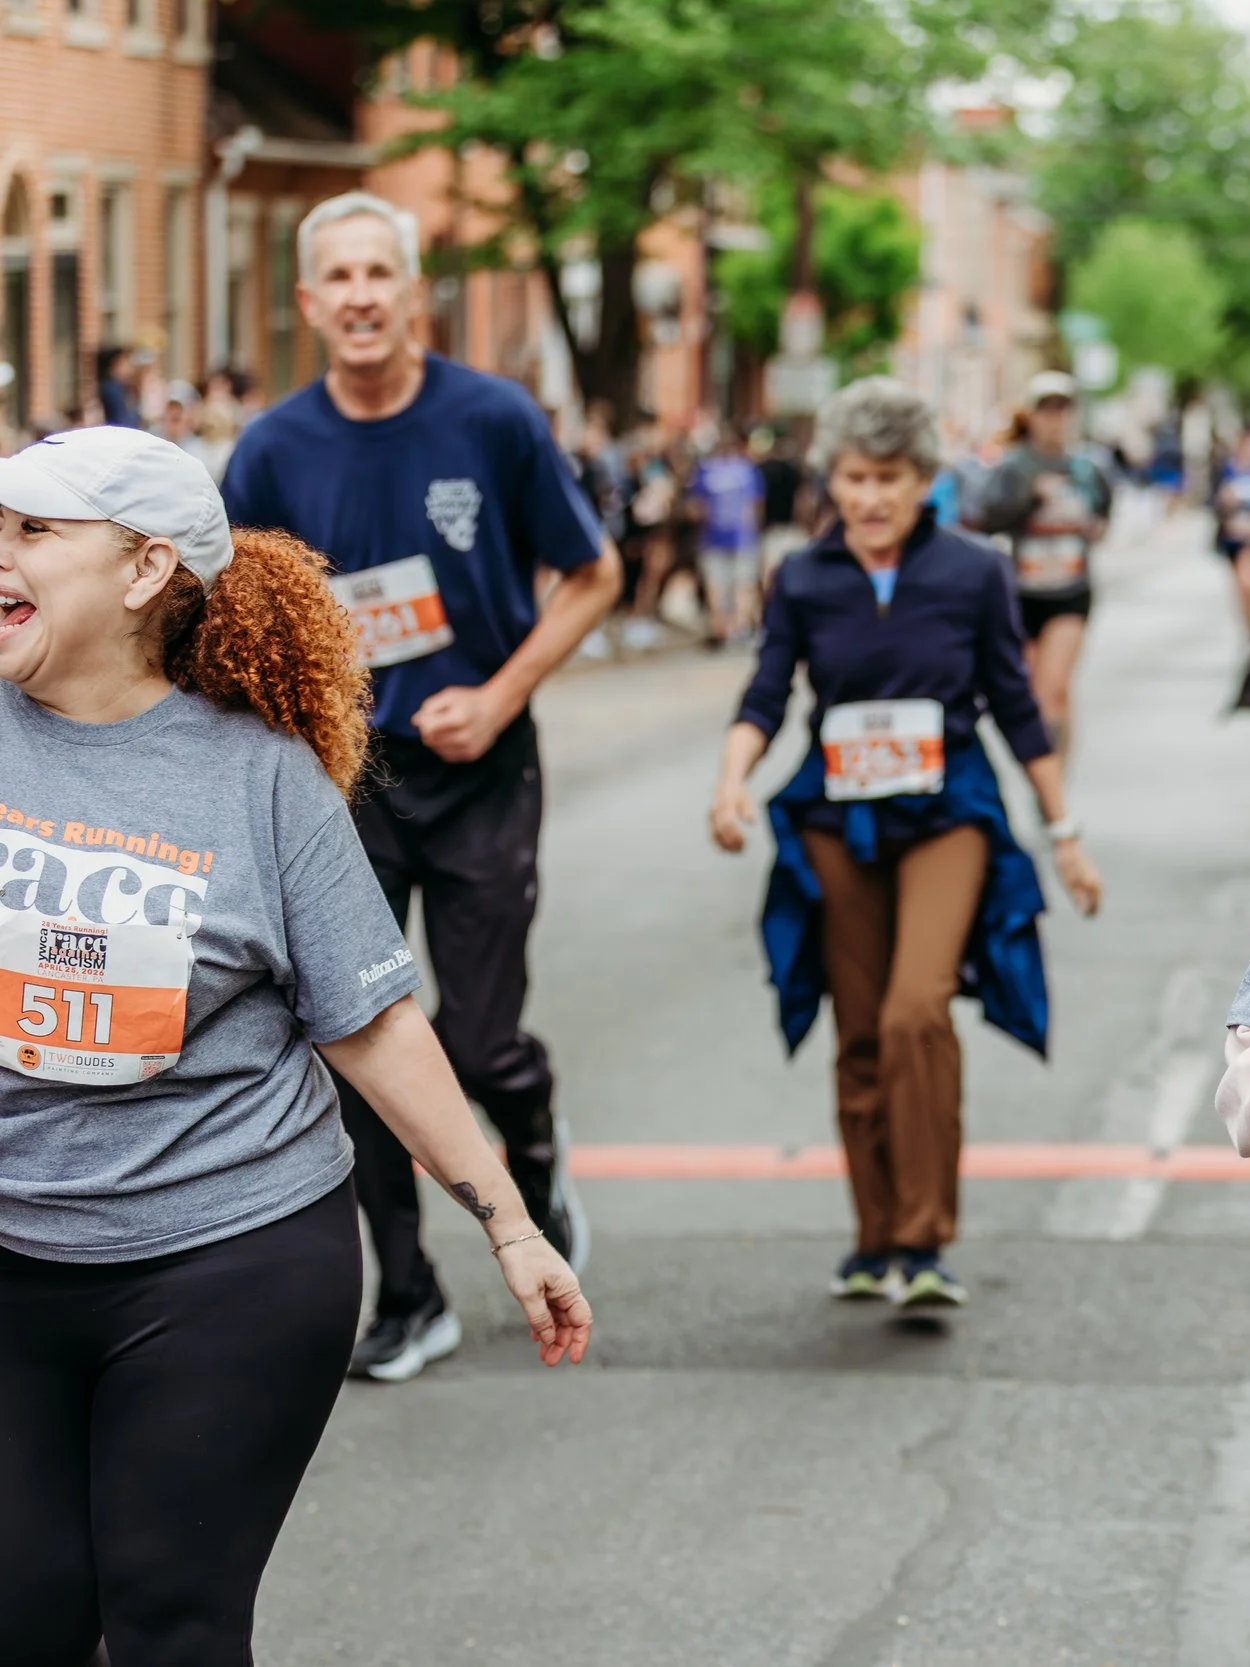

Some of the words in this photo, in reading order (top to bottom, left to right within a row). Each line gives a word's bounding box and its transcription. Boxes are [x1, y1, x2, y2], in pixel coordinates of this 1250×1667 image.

[63, 821, 214, 875] Running!
[39, 928, 48, 961] ywca
[51, 932, 107, 952] race
[38, 962, 63, 972] APRIL
[65, 966, 79, 975] 25,
[81, 968, 104, 977] 2026
[49, 951, 105, 969] RACISM
[358, 959, 400, 988] Fulton
[17, 982, 113, 1045] 511
